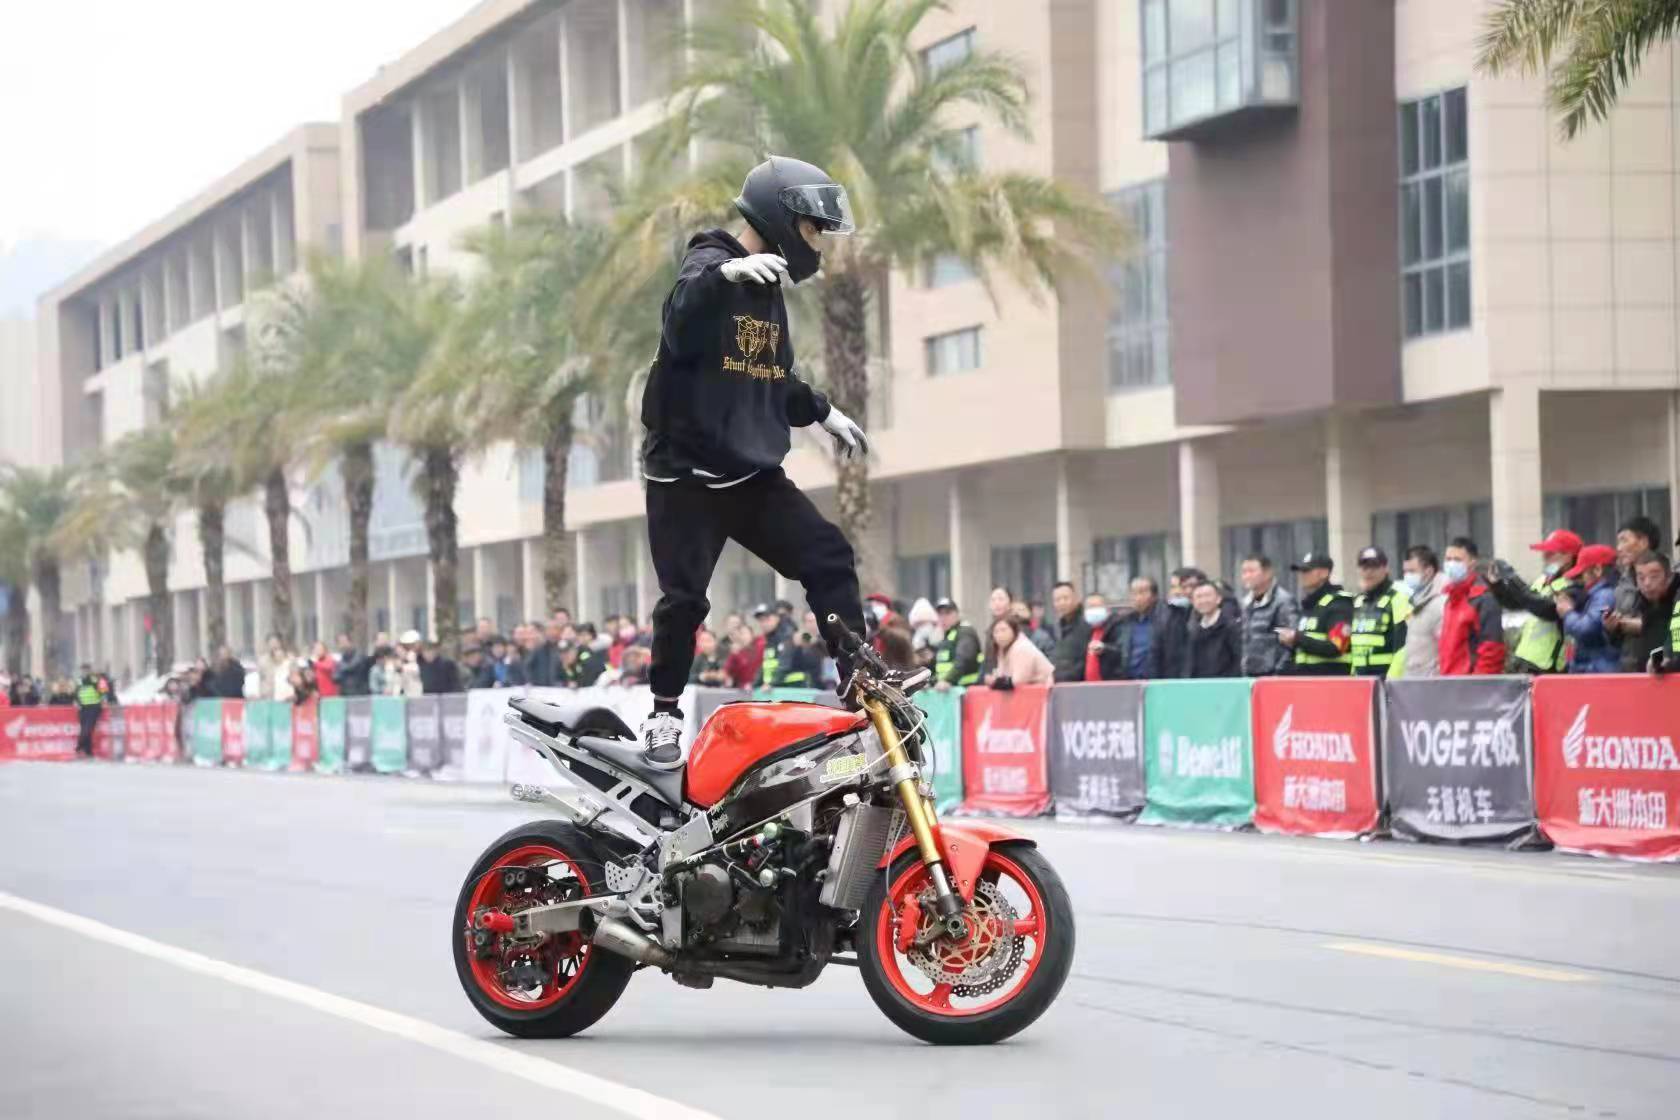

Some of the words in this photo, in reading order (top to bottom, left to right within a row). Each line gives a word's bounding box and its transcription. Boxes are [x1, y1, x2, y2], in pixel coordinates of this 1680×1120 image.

[1061, 720, 1105, 761] VOGE
[1290, 731, 1359, 764] HONDA
[1400, 720, 1469, 767] VOGE
[1584, 735, 1680, 771] HONDA
